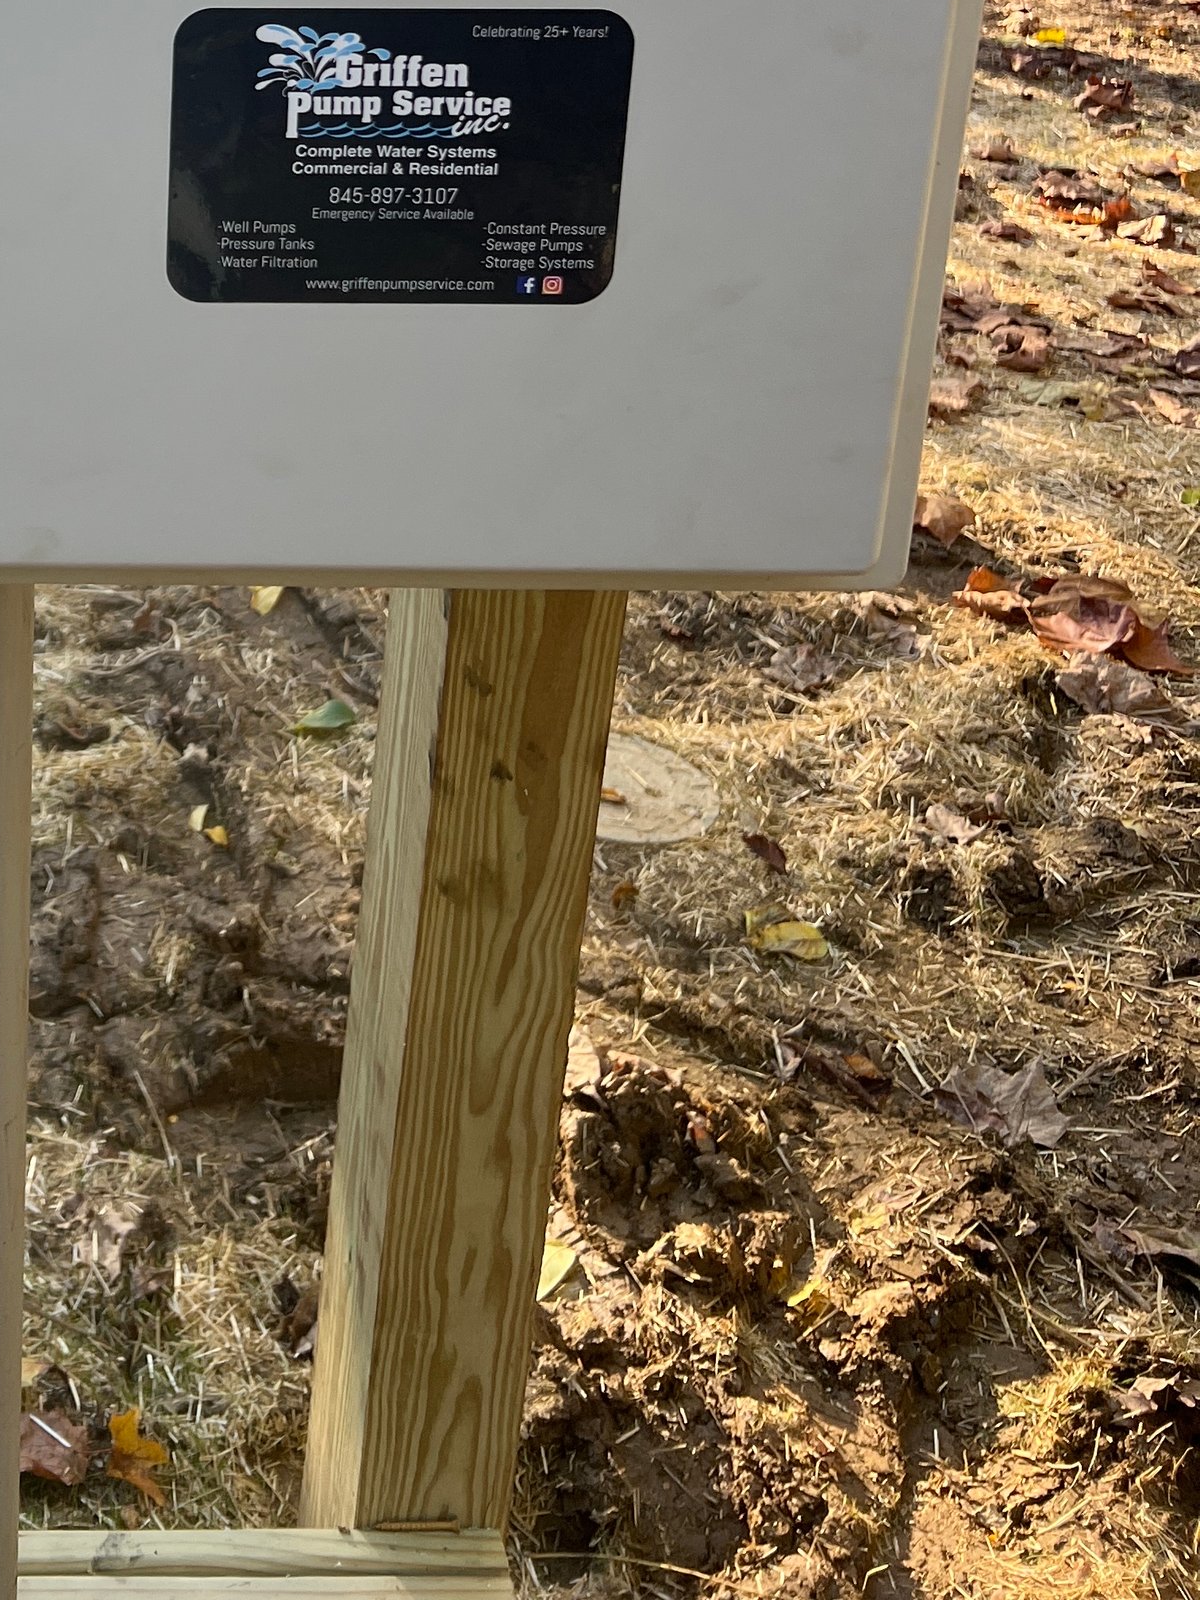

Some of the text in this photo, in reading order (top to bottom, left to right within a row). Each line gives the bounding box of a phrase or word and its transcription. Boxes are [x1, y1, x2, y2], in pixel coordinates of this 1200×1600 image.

[472, 26, 609, 40] Celebrating 25+ Years!
[336, 53, 469, 88] Griffen
[285, 89, 511, 138] Pump Service
[451, 112, 510, 136] inc.
[295, 145, 496, 160] Complete Water Systems
[292, 161, 499, 176] Commercial & Residential
[328, 187, 458, 204] 845-897-3107
[311, 207, 474, 221] Emergency Service Available
[217, 221, 296, 236] -Well Pumps
[482, 222, 606, 236] -Constant Pressure
[216, 238, 314, 250] -Pressure Tanks
[481, 239, 583, 253] -Sewage Pumps
[216, 255, 318, 268] -Water Filtration
[480, 257, 594, 271] -Storage Systems
[305, 277, 494, 293] www.griffenpumpservice.com
